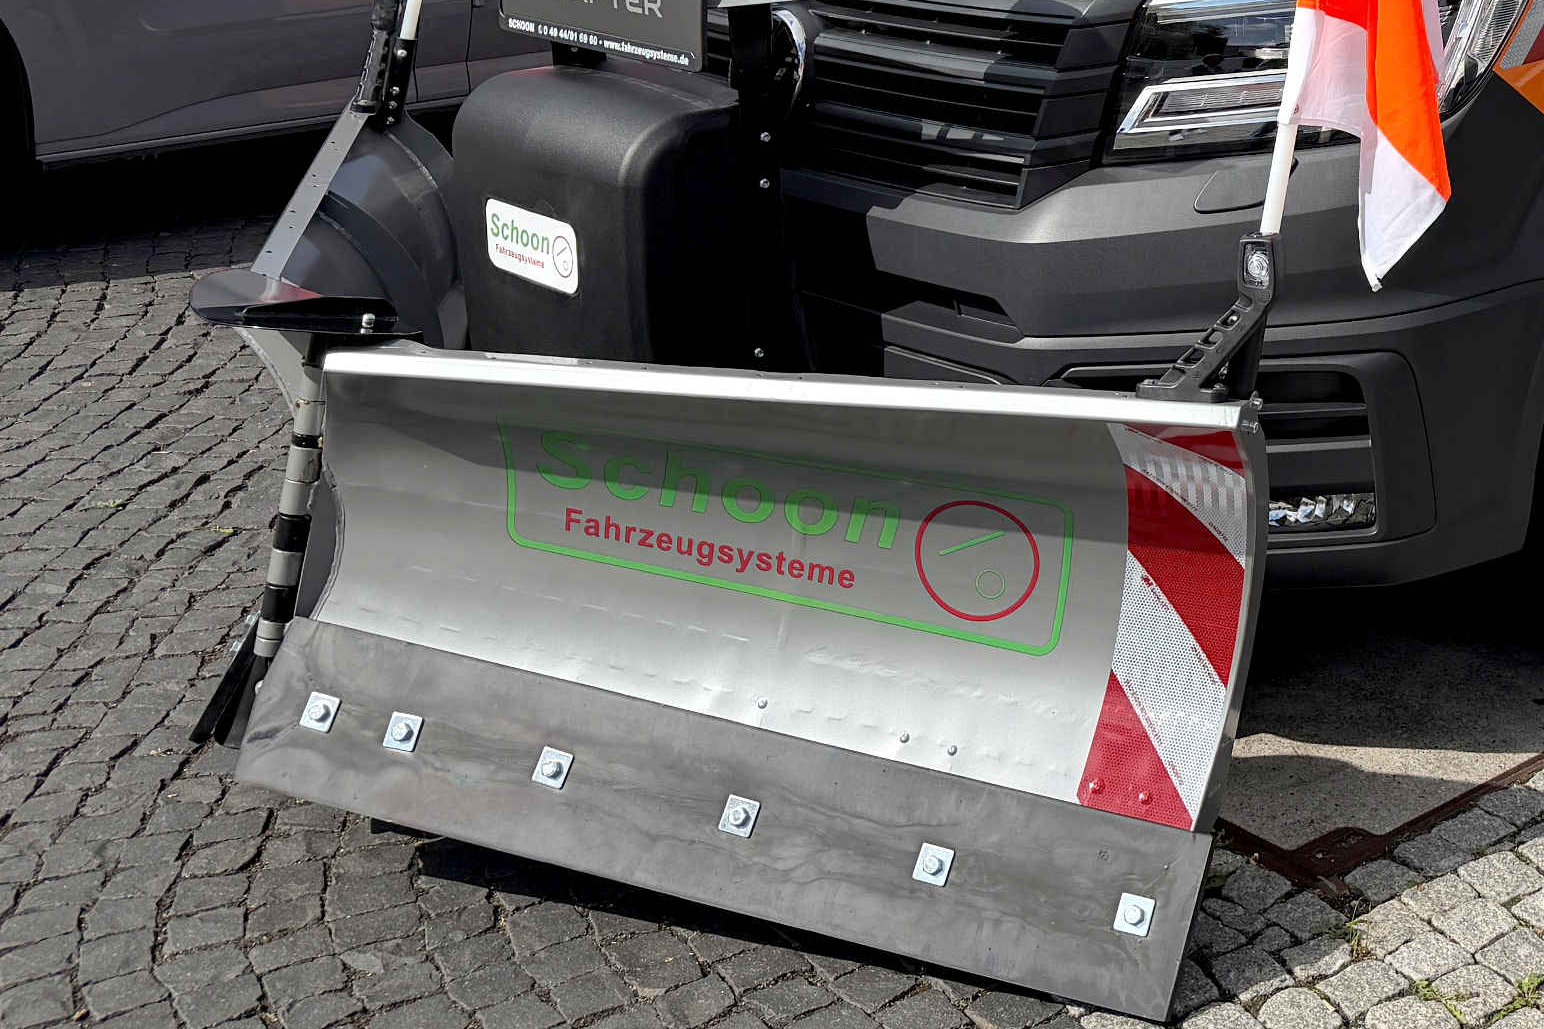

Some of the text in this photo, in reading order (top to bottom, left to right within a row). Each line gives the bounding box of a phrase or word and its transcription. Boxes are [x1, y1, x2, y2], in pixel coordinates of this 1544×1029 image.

[508, 17, 535, 33] SCHOON
[490, 212, 550, 255] Schoon
[535, 429, 902, 551] Schoon
[563, 507, 856, 589] Fahrzeugsysteme
